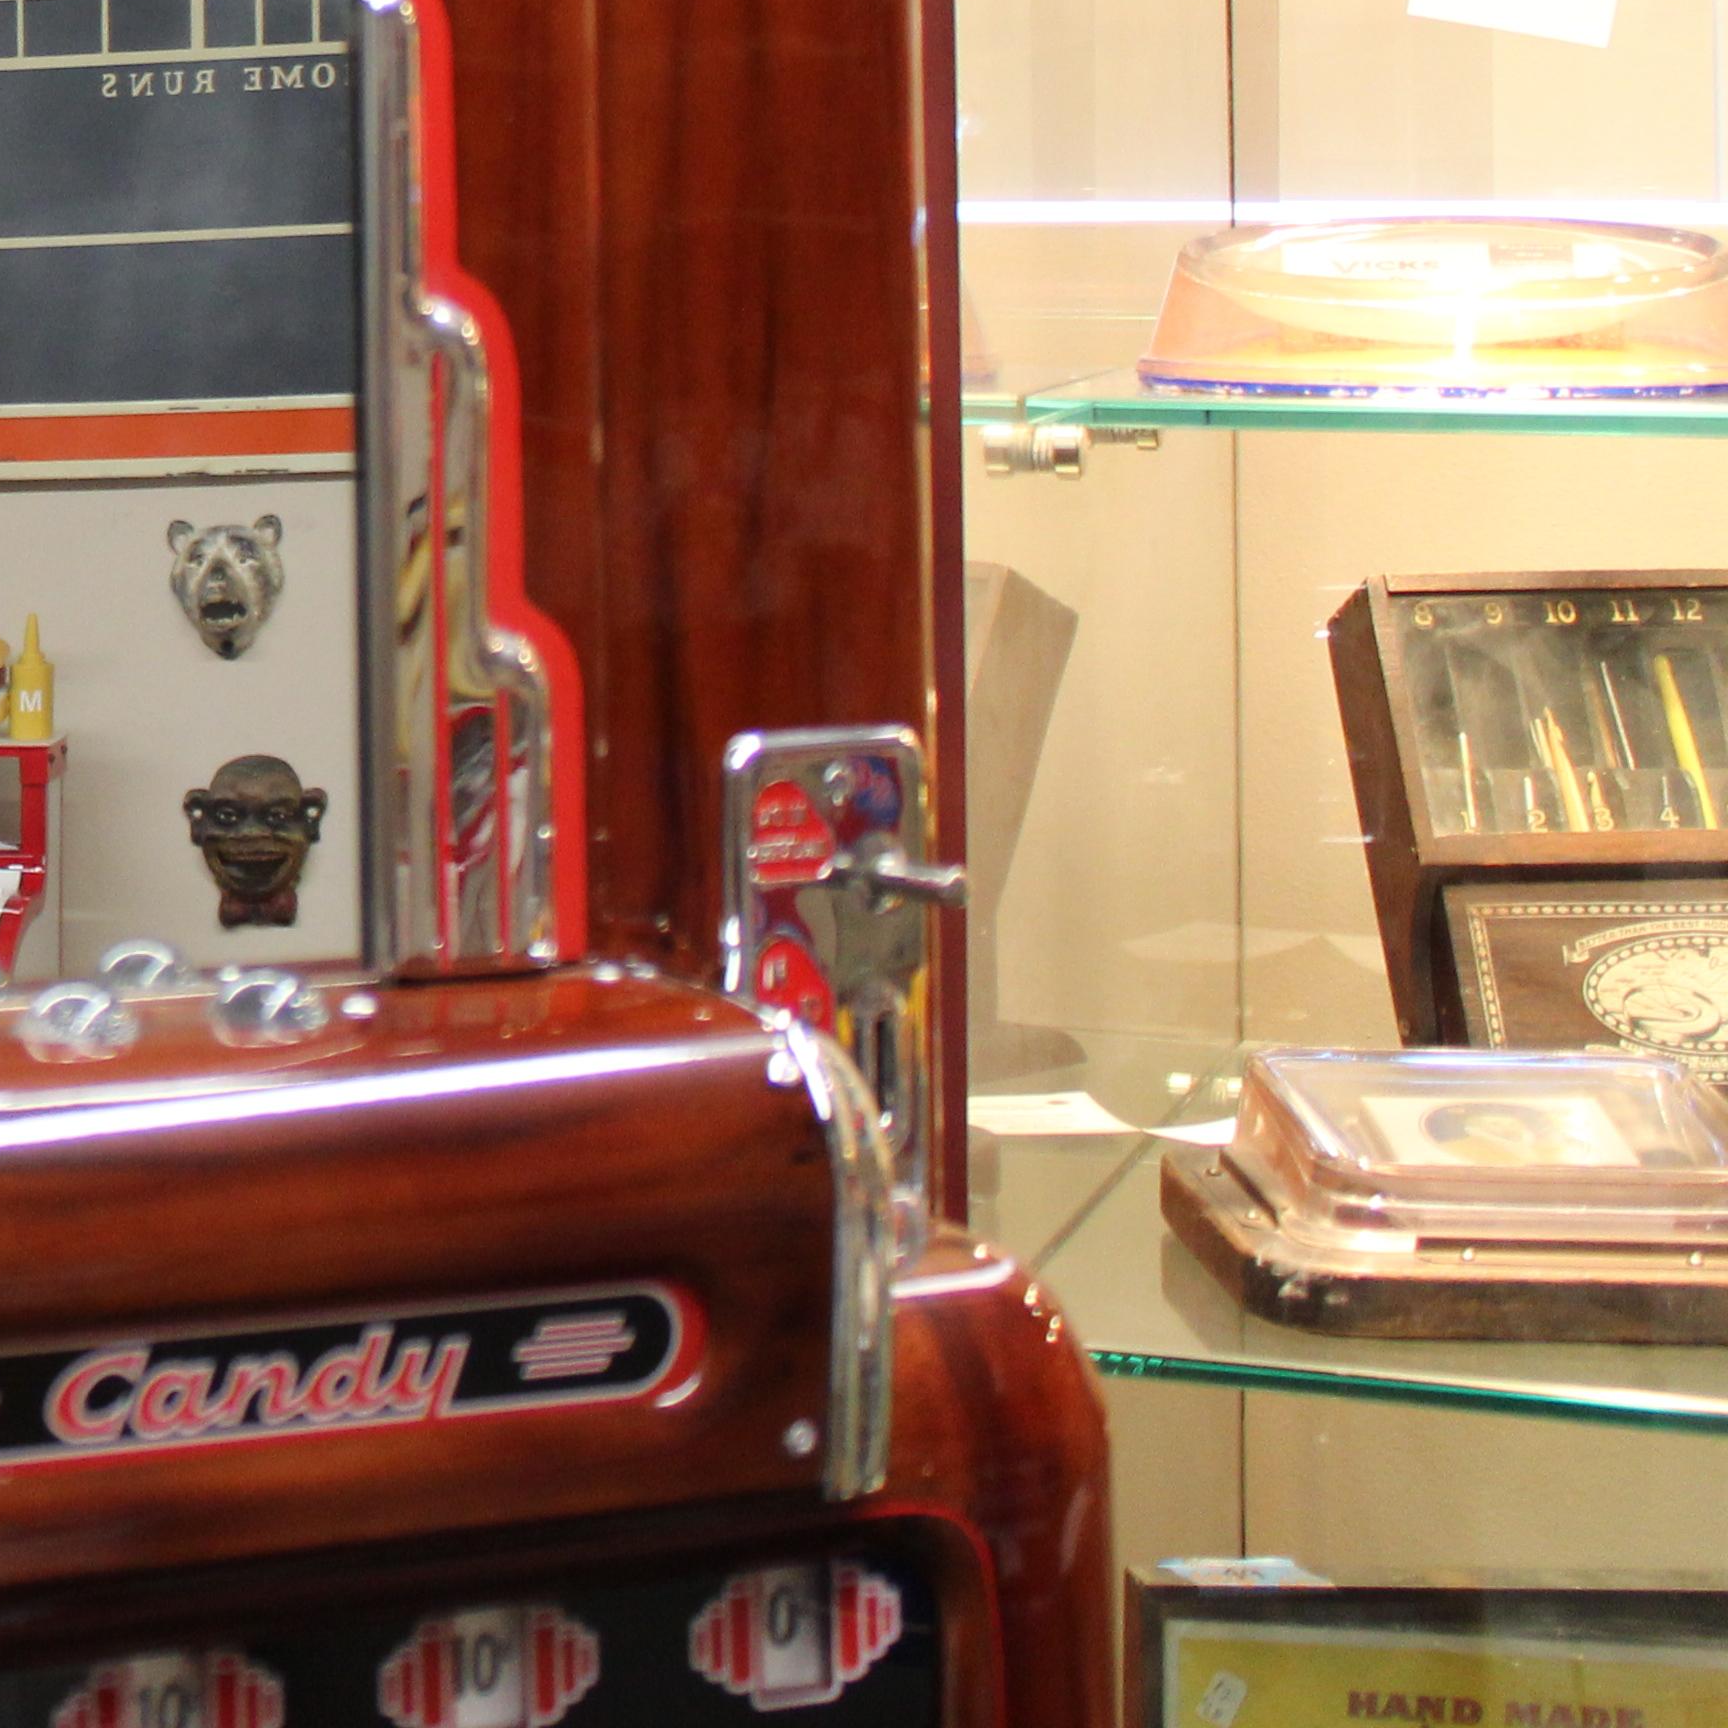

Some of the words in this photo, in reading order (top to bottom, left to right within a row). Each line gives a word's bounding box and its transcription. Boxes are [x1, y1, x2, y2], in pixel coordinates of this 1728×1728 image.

[1331, 260, 1440, 274] VICKS
[1413, 603, 1434, 627] 8
[1484, 600, 1504, 625] 9
[1544, 599, 1578, 625] 10
[1609, 598, 1640, 623] 11
[1671, 597, 1704, 622] 12
[1528, 809, 1549, 833] 2
[1593, 807, 1615, 832] 3
[1660, 805, 1681, 830] 4
[46, 1320, 470, 1446] Candy
[1347, 1691, 1484, 1726] HAND
[1504, 1700, 1643, 1728] MADE
